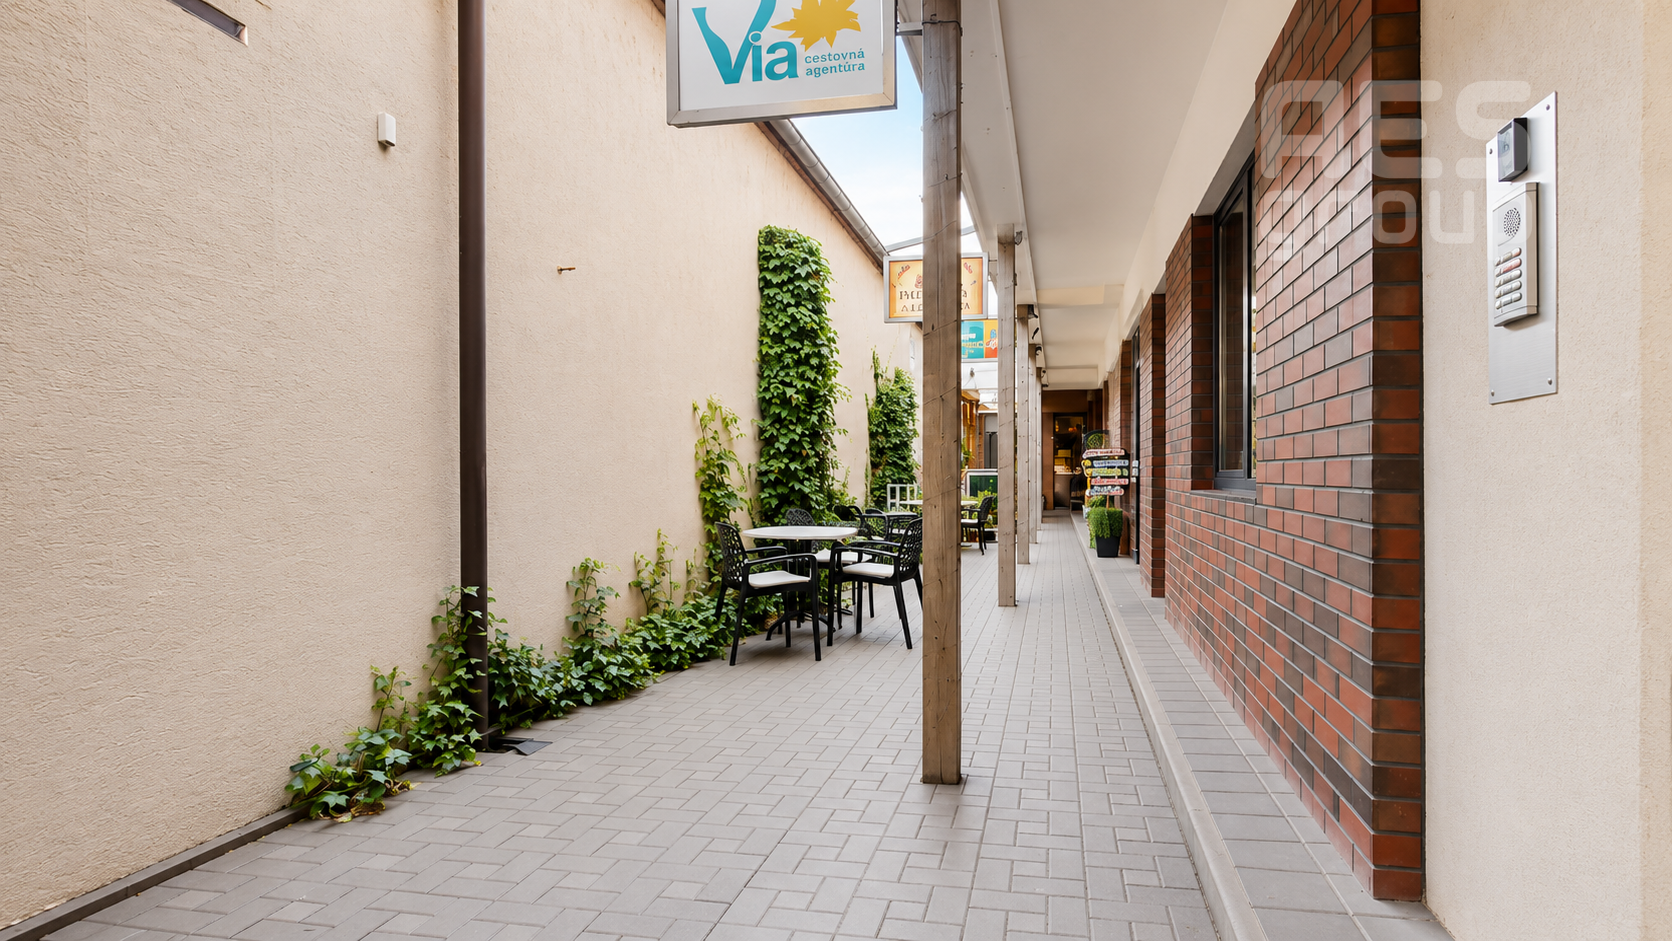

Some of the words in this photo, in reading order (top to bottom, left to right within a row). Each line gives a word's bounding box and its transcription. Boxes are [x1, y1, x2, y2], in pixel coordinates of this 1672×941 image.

[692, 0, 799, 85] Via
[804, 48, 865, 64] cestovná
[805, 62, 865, 78] agentúra
